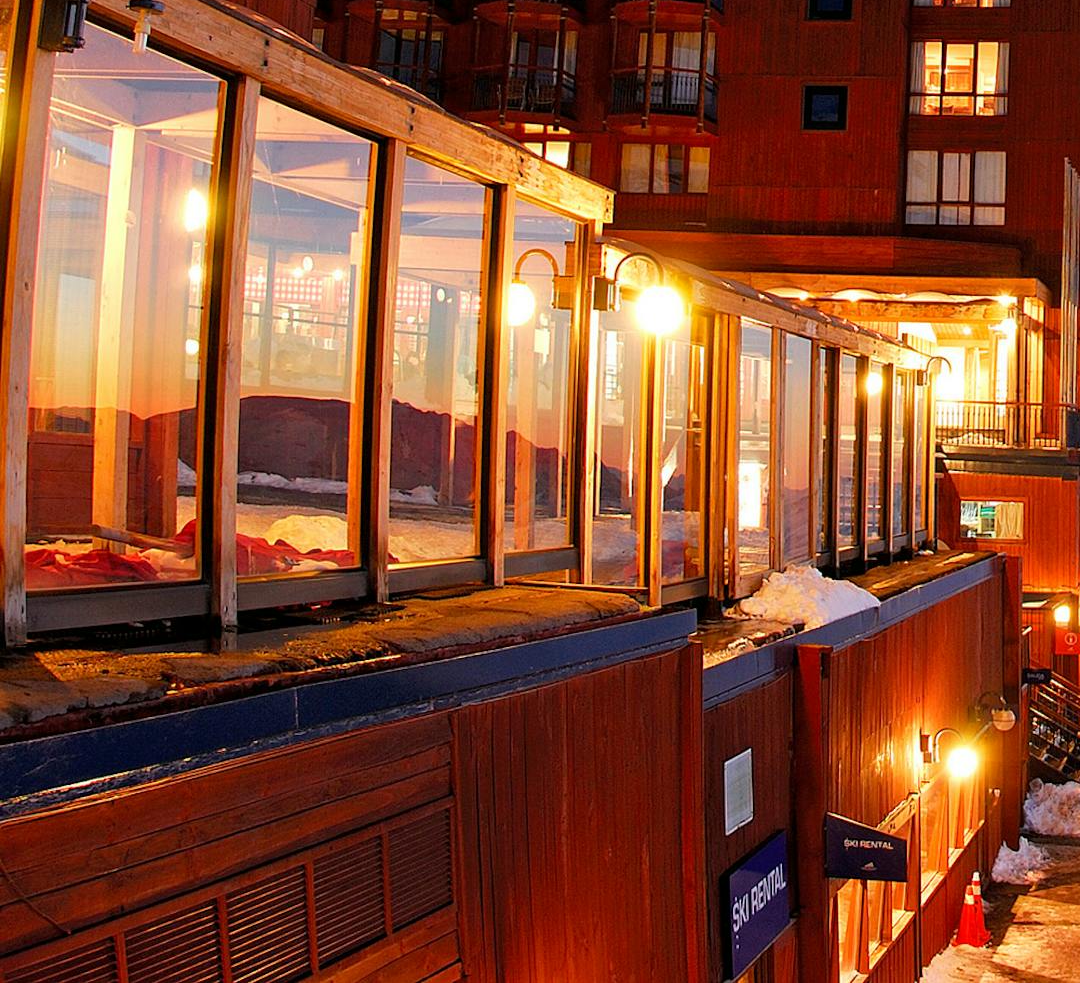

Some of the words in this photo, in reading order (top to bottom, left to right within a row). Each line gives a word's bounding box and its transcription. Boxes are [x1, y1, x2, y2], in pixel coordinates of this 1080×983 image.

[843, 839, 859, 849] SKI
[860, 840, 894, 850] RENTAL
[732, 893, 750, 932] SKI
[751, 863, 787, 915] RENTAL
